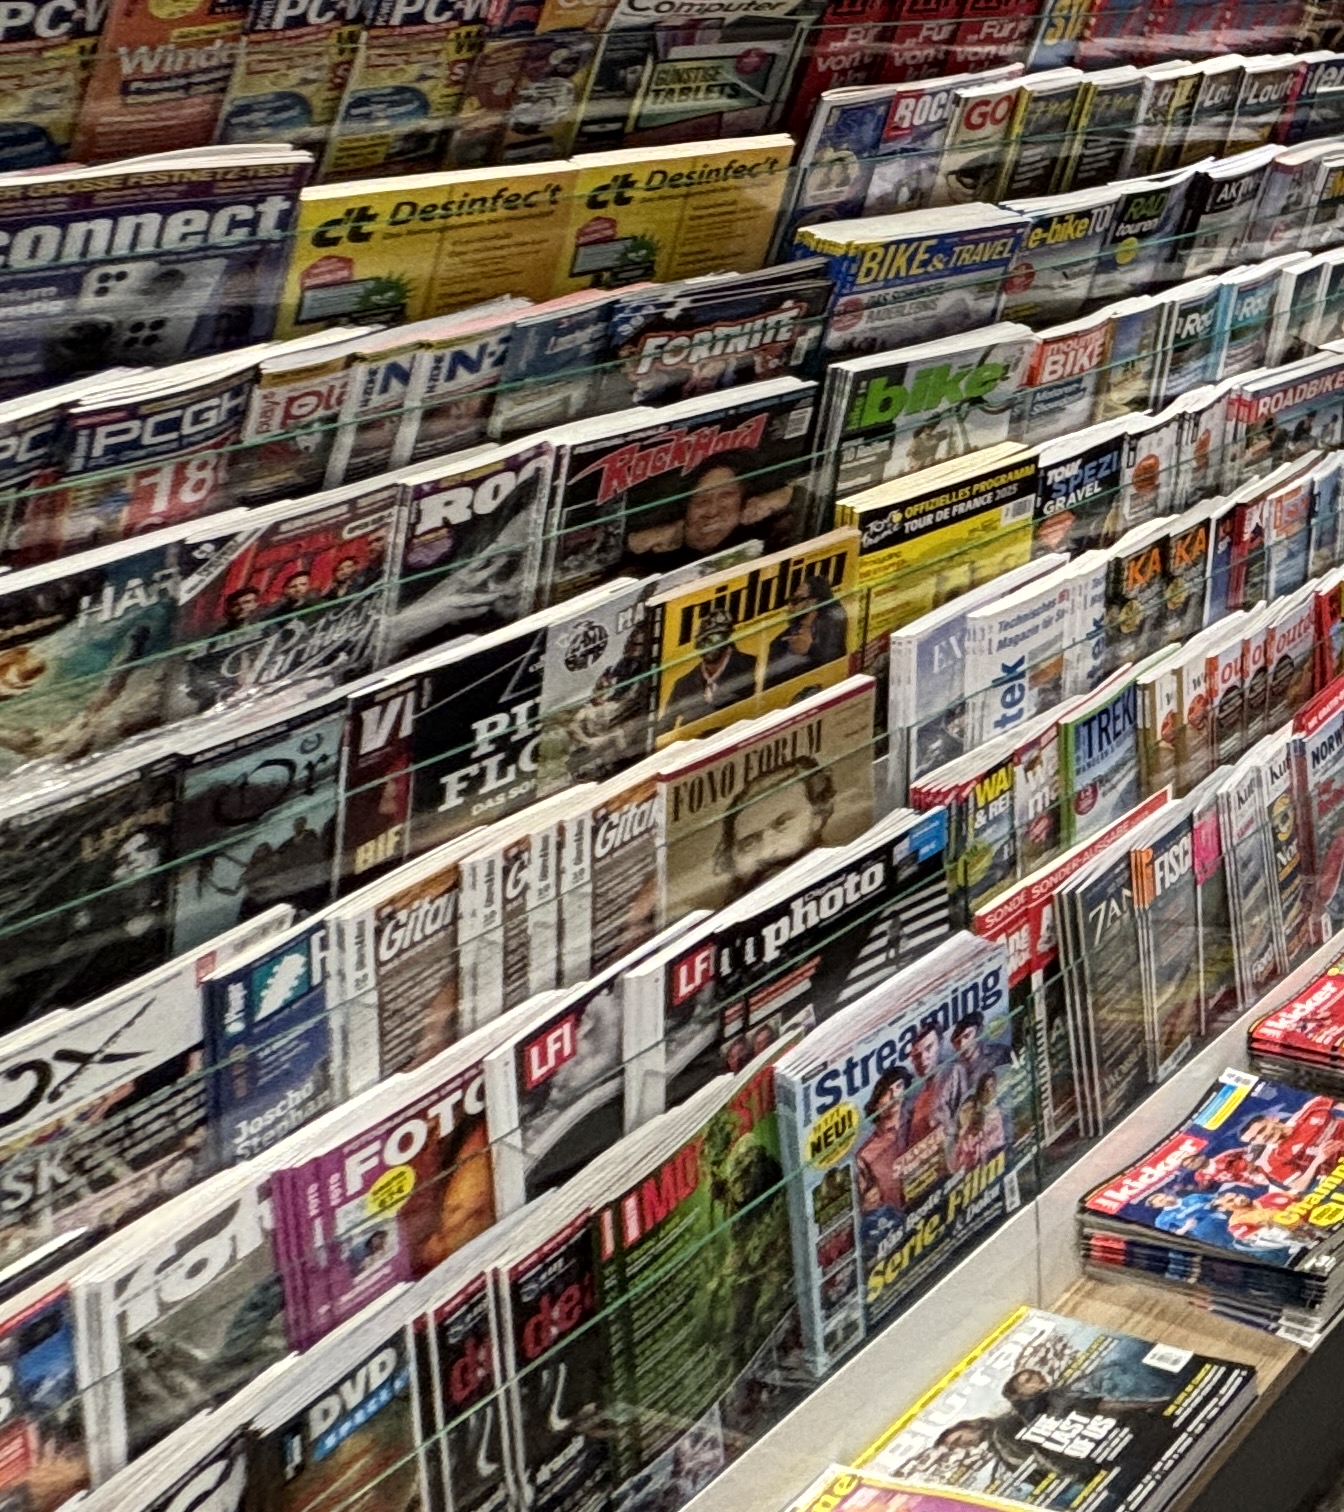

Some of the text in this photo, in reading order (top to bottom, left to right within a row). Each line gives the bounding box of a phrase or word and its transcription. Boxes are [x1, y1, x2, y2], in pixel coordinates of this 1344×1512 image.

[855, 239, 930, 285] BIKE
[952, 235, 1016, 270] TRAVEL
[762, 862, 886, 964] photo
[814, 963, 1003, 1117] Streaming
[309, 1345, 398, 1438] DVD
